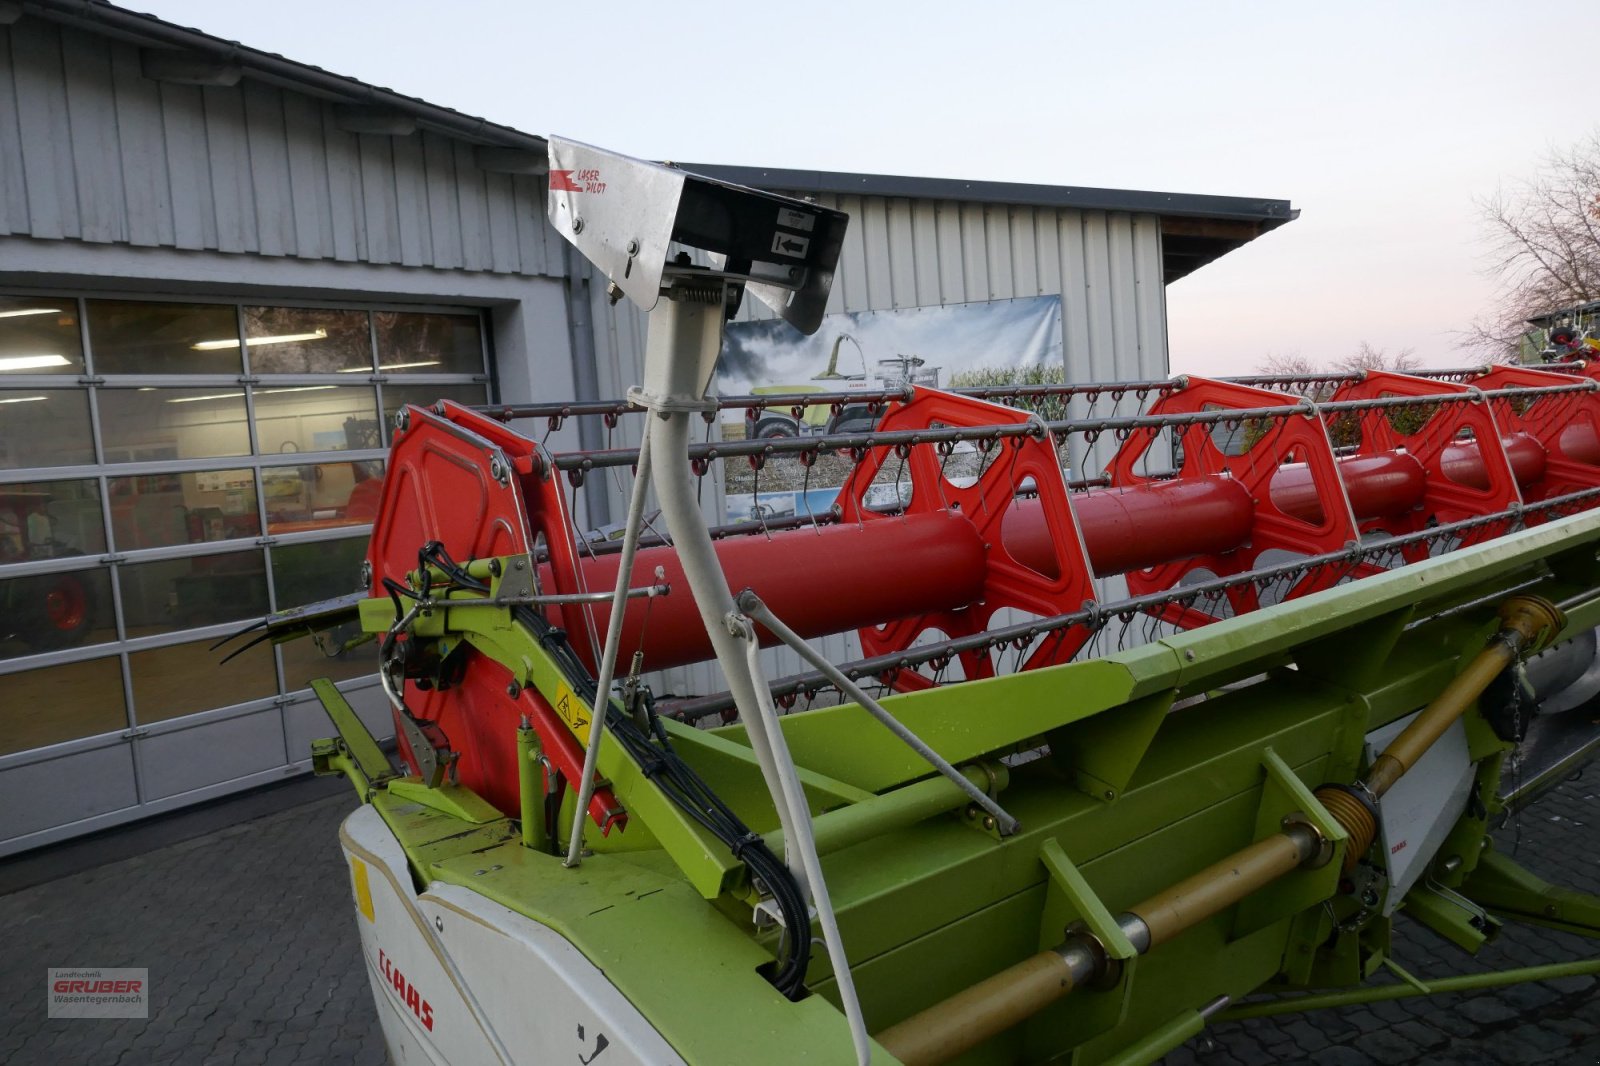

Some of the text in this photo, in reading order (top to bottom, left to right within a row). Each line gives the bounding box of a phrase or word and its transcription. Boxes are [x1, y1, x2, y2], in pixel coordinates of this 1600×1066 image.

[577, 169, 600, 182] LASER
[586, 182, 607, 195] PILOT
[379, 948, 434, 1032] CLAAS
